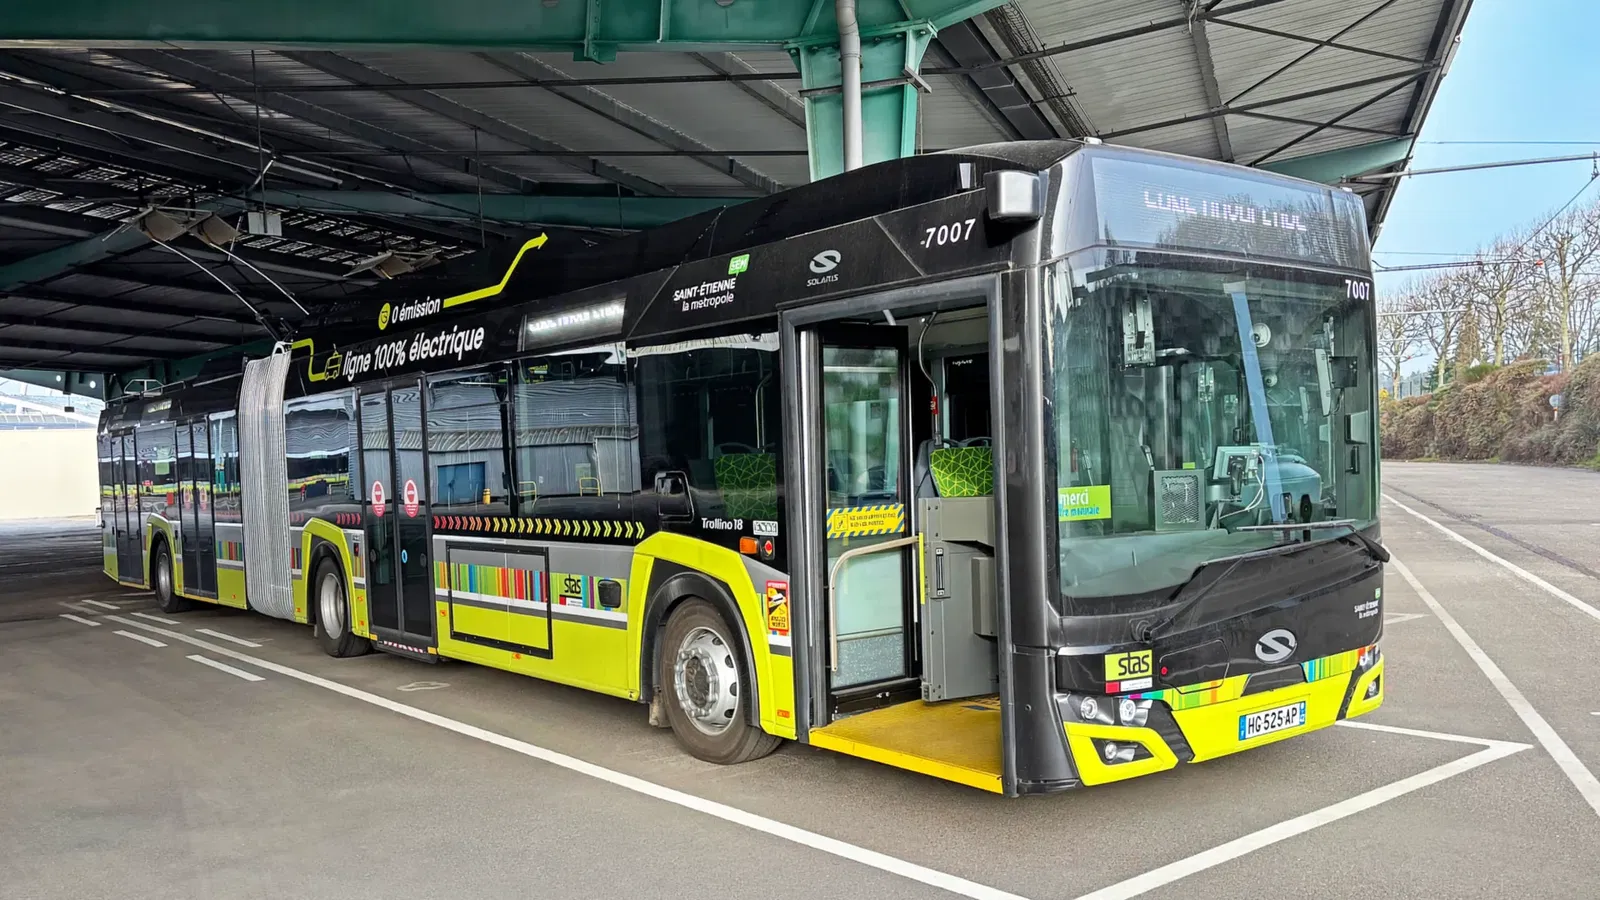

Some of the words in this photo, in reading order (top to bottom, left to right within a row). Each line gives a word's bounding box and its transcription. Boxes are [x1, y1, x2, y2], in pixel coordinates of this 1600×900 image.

[925, 217, 977, 249] 7007
[673, 277, 737, 301] SAINT-ÉTIENNE
[1345, 279, 1370, 301] 7007
[391, 305, 399, 324] 0
[399, 296, 441, 322] émission
[682, 300, 690, 312] la
[342, 350, 371, 382] ligne
[373, 339, 408, 370] 100%
[408, 324, 485, 361] électrique
[1058, 487, 1091, 506] merci
[701, 517, 733, 530] Trollino
[733, 518, 744, 531] 18
[563, 572, 583, 594] stas
[1117, 651, 1151, 677] stas
